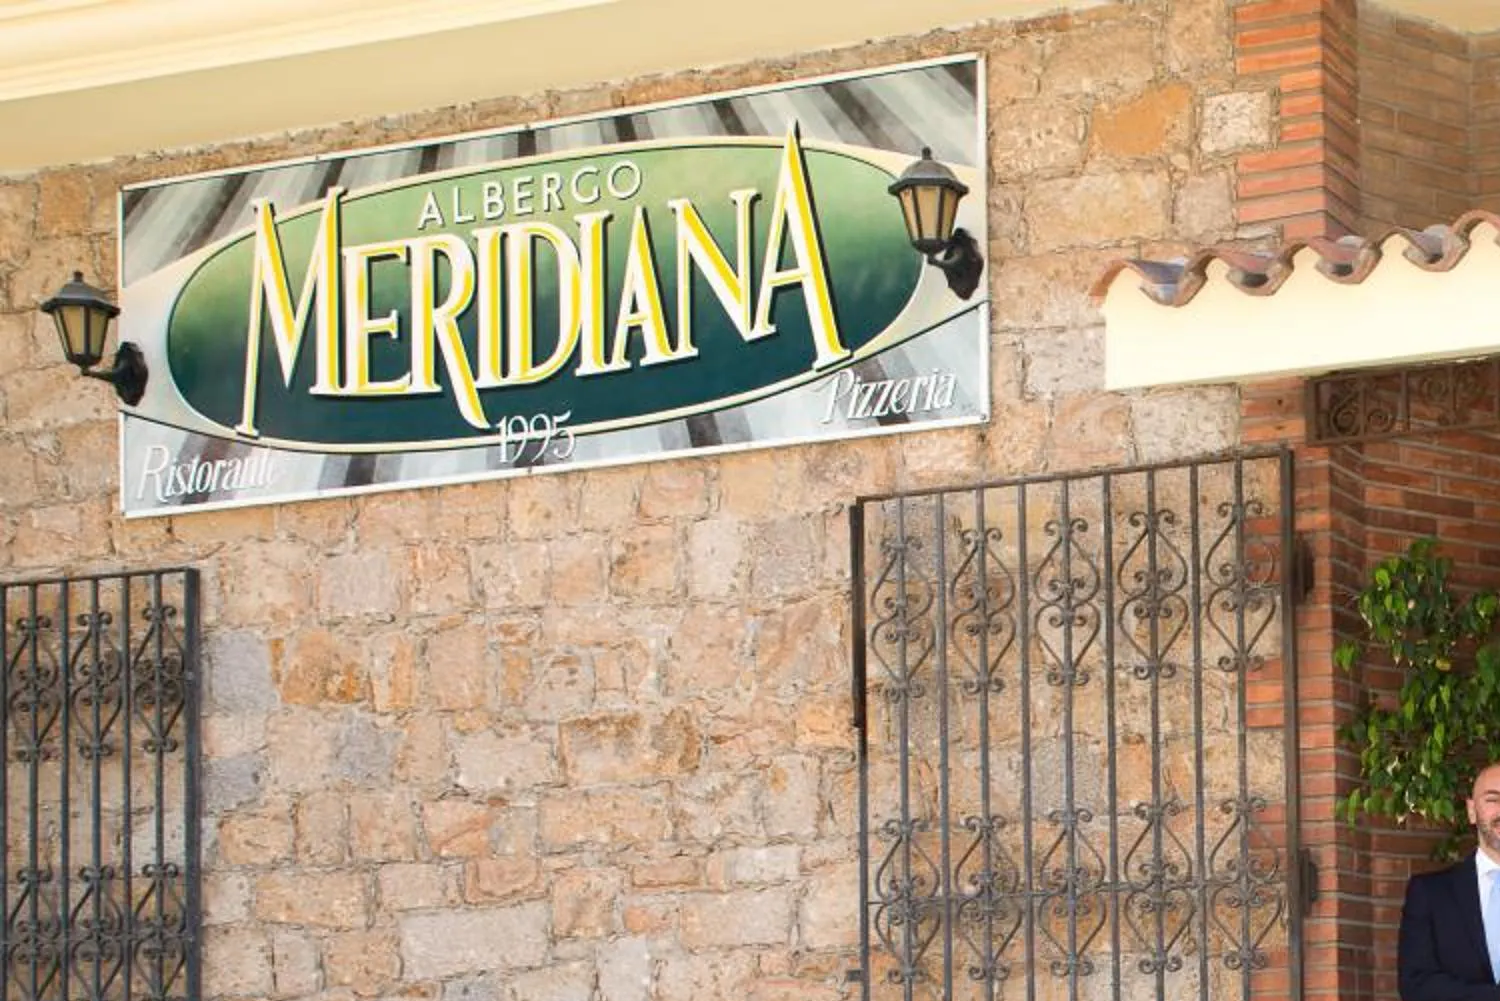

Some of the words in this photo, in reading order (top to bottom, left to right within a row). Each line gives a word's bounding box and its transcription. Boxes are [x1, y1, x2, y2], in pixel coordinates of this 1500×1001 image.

[417, 160, 641, 230] ALBERGO
[235, 118, 852, 437] MERIDIANA
[818, 368, 957, 424] Pizzeria
[497, 410, 575, 463] 1995
[136, 444, 279, 502] Ristorante
